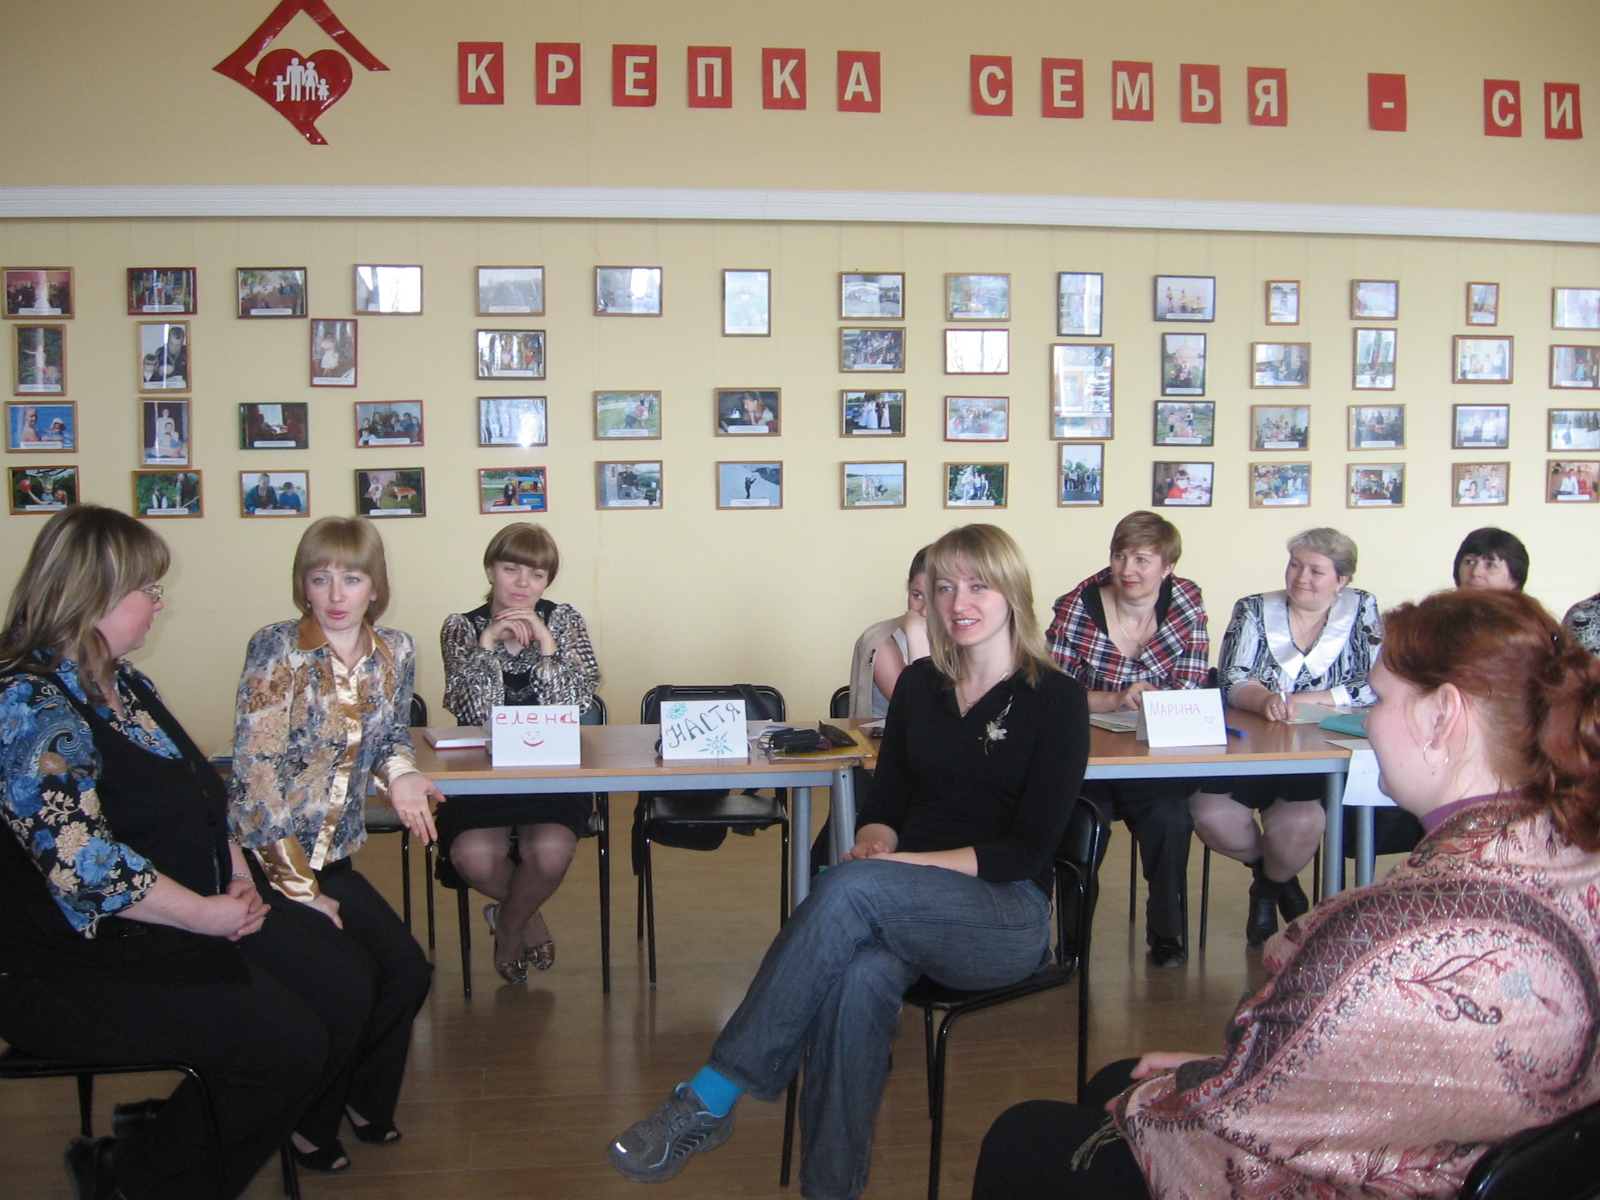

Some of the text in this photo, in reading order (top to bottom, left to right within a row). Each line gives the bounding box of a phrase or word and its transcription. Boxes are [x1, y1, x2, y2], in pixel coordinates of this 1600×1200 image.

[467, 53, 873, 102] КРЕПКА
[977, 65, 1280, 118] СЕМЬЯ
[1490, 89, 1575, 131] СИ
[495, 710, 578, 726] елена
[665, 701, 742, 749] НАСТЯ
[1149, 701, 1202, 717] МАРИНА
